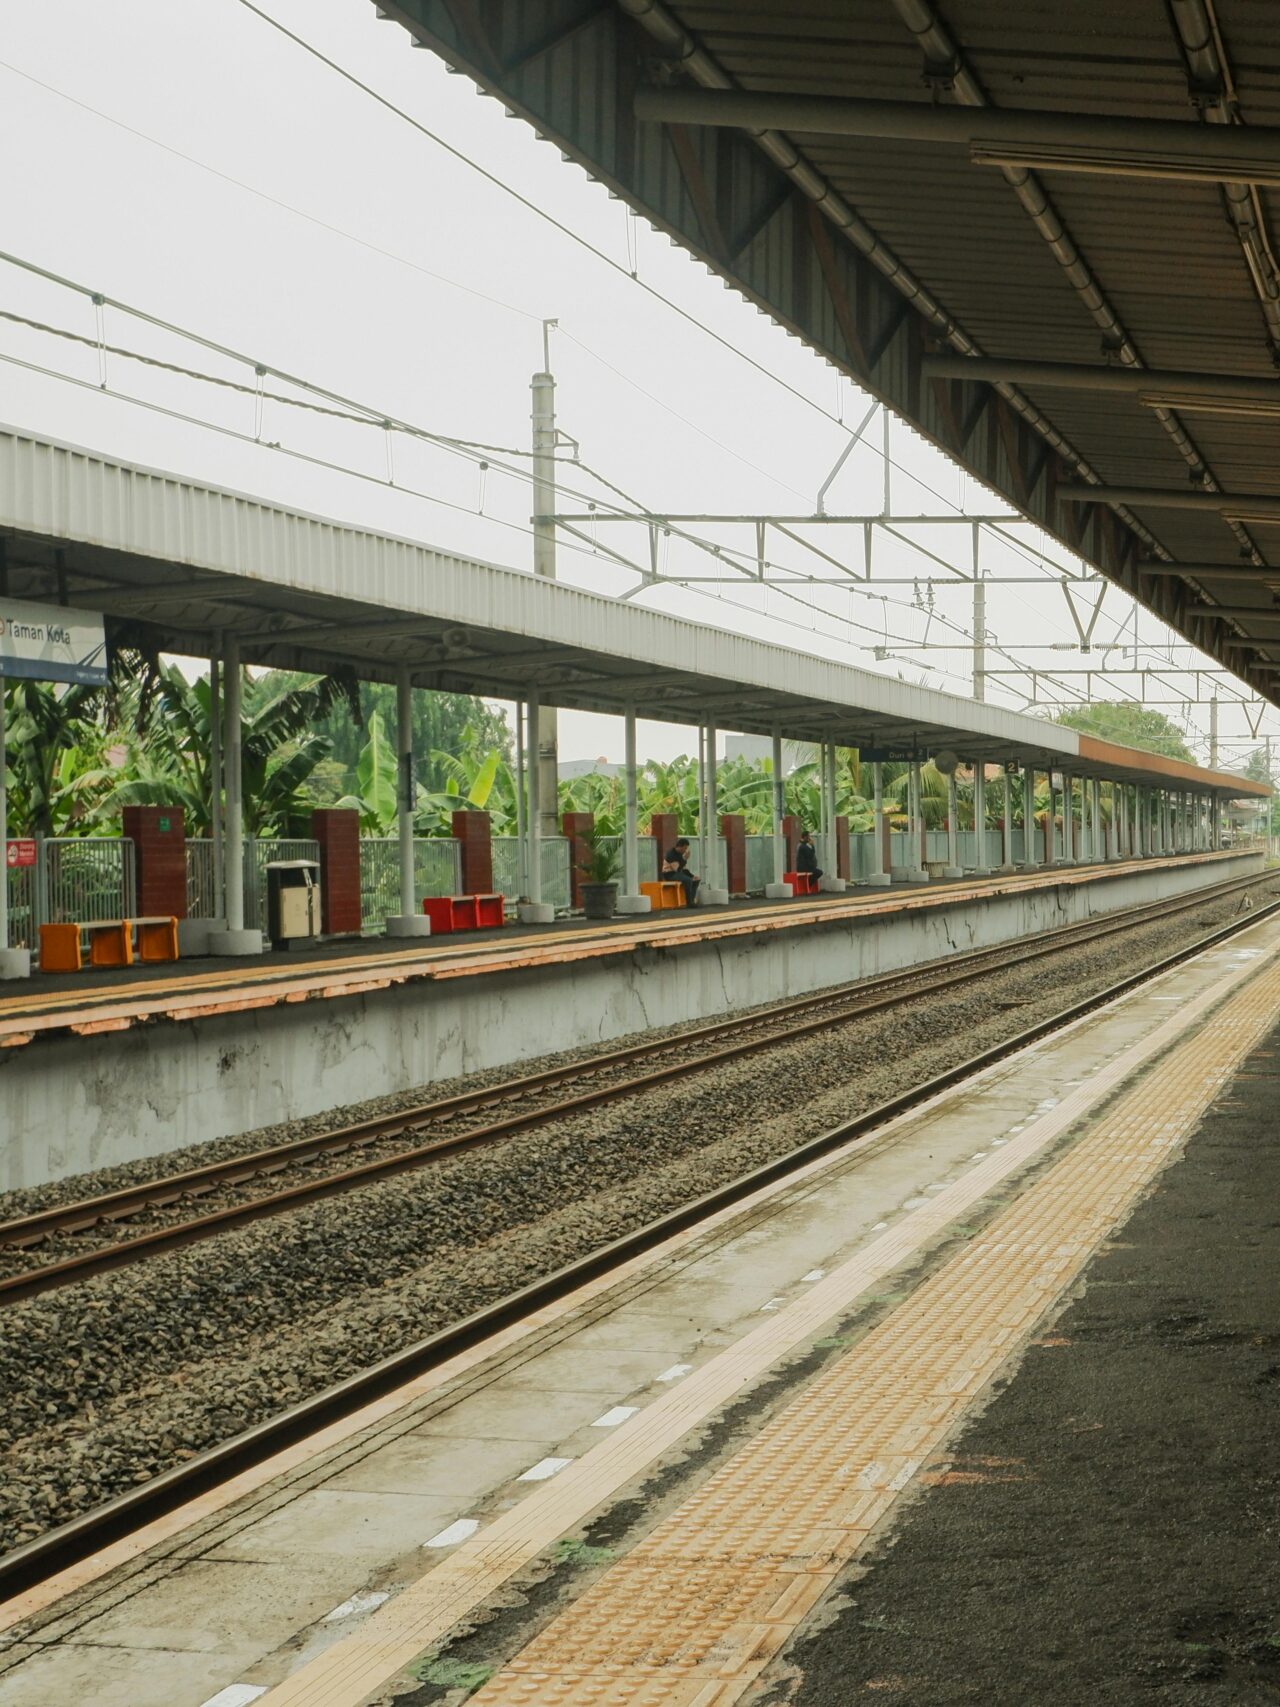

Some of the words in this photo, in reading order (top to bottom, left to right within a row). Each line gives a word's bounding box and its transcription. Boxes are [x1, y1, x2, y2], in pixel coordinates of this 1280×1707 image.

[6, 619, 44, 640] Taman
[46, 624, 71, 645] Kota
[1008, 762, 1016, 771] 2
